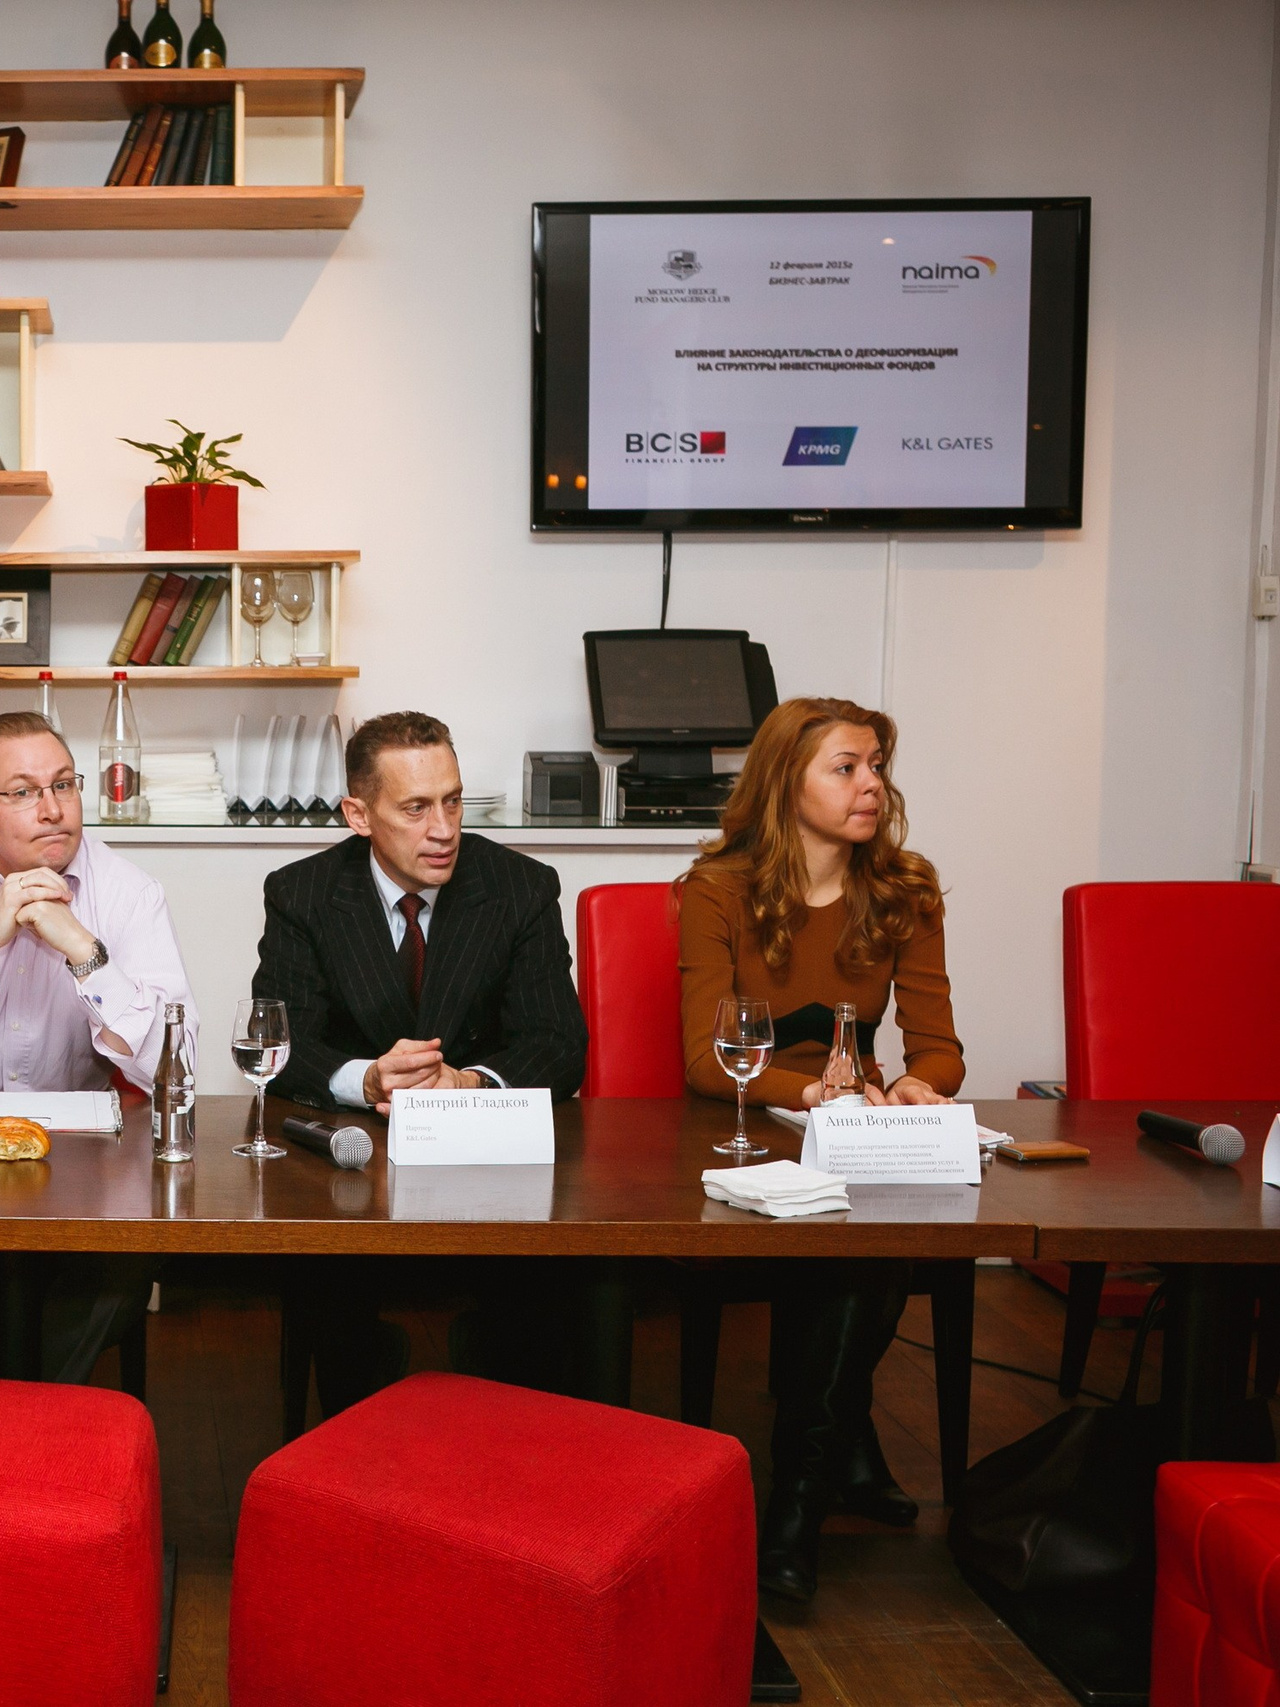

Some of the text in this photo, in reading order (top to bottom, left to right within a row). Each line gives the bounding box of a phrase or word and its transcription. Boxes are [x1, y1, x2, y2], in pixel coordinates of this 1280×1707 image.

[783, 261, 823, 271] февраля
[902, 263, 980, 279] naima
[769, 277, 850, 285] БИЗНЕС-ЗАВТРАК
[675, 348, 958, 359] ВЛИЯНИЕ ЗАКОНОДАТЕЛЬСТВА О ДЕОФШОРИЗАЦИИ
[697, 361, 935, 372] НА СТРУКТУРЫ ИНВЕСТИЦИОННЫХ ФОНДОВ
[902, 437, 993, 450] K&L GATES
[798, 444, 841, 455] KPMG
[404, 1097, 529, 1110] Дмитрий Гладков
[826, 1115, 942, 1129] Анна Воронкова
[828, 1144, 855, 1152] Партнер
